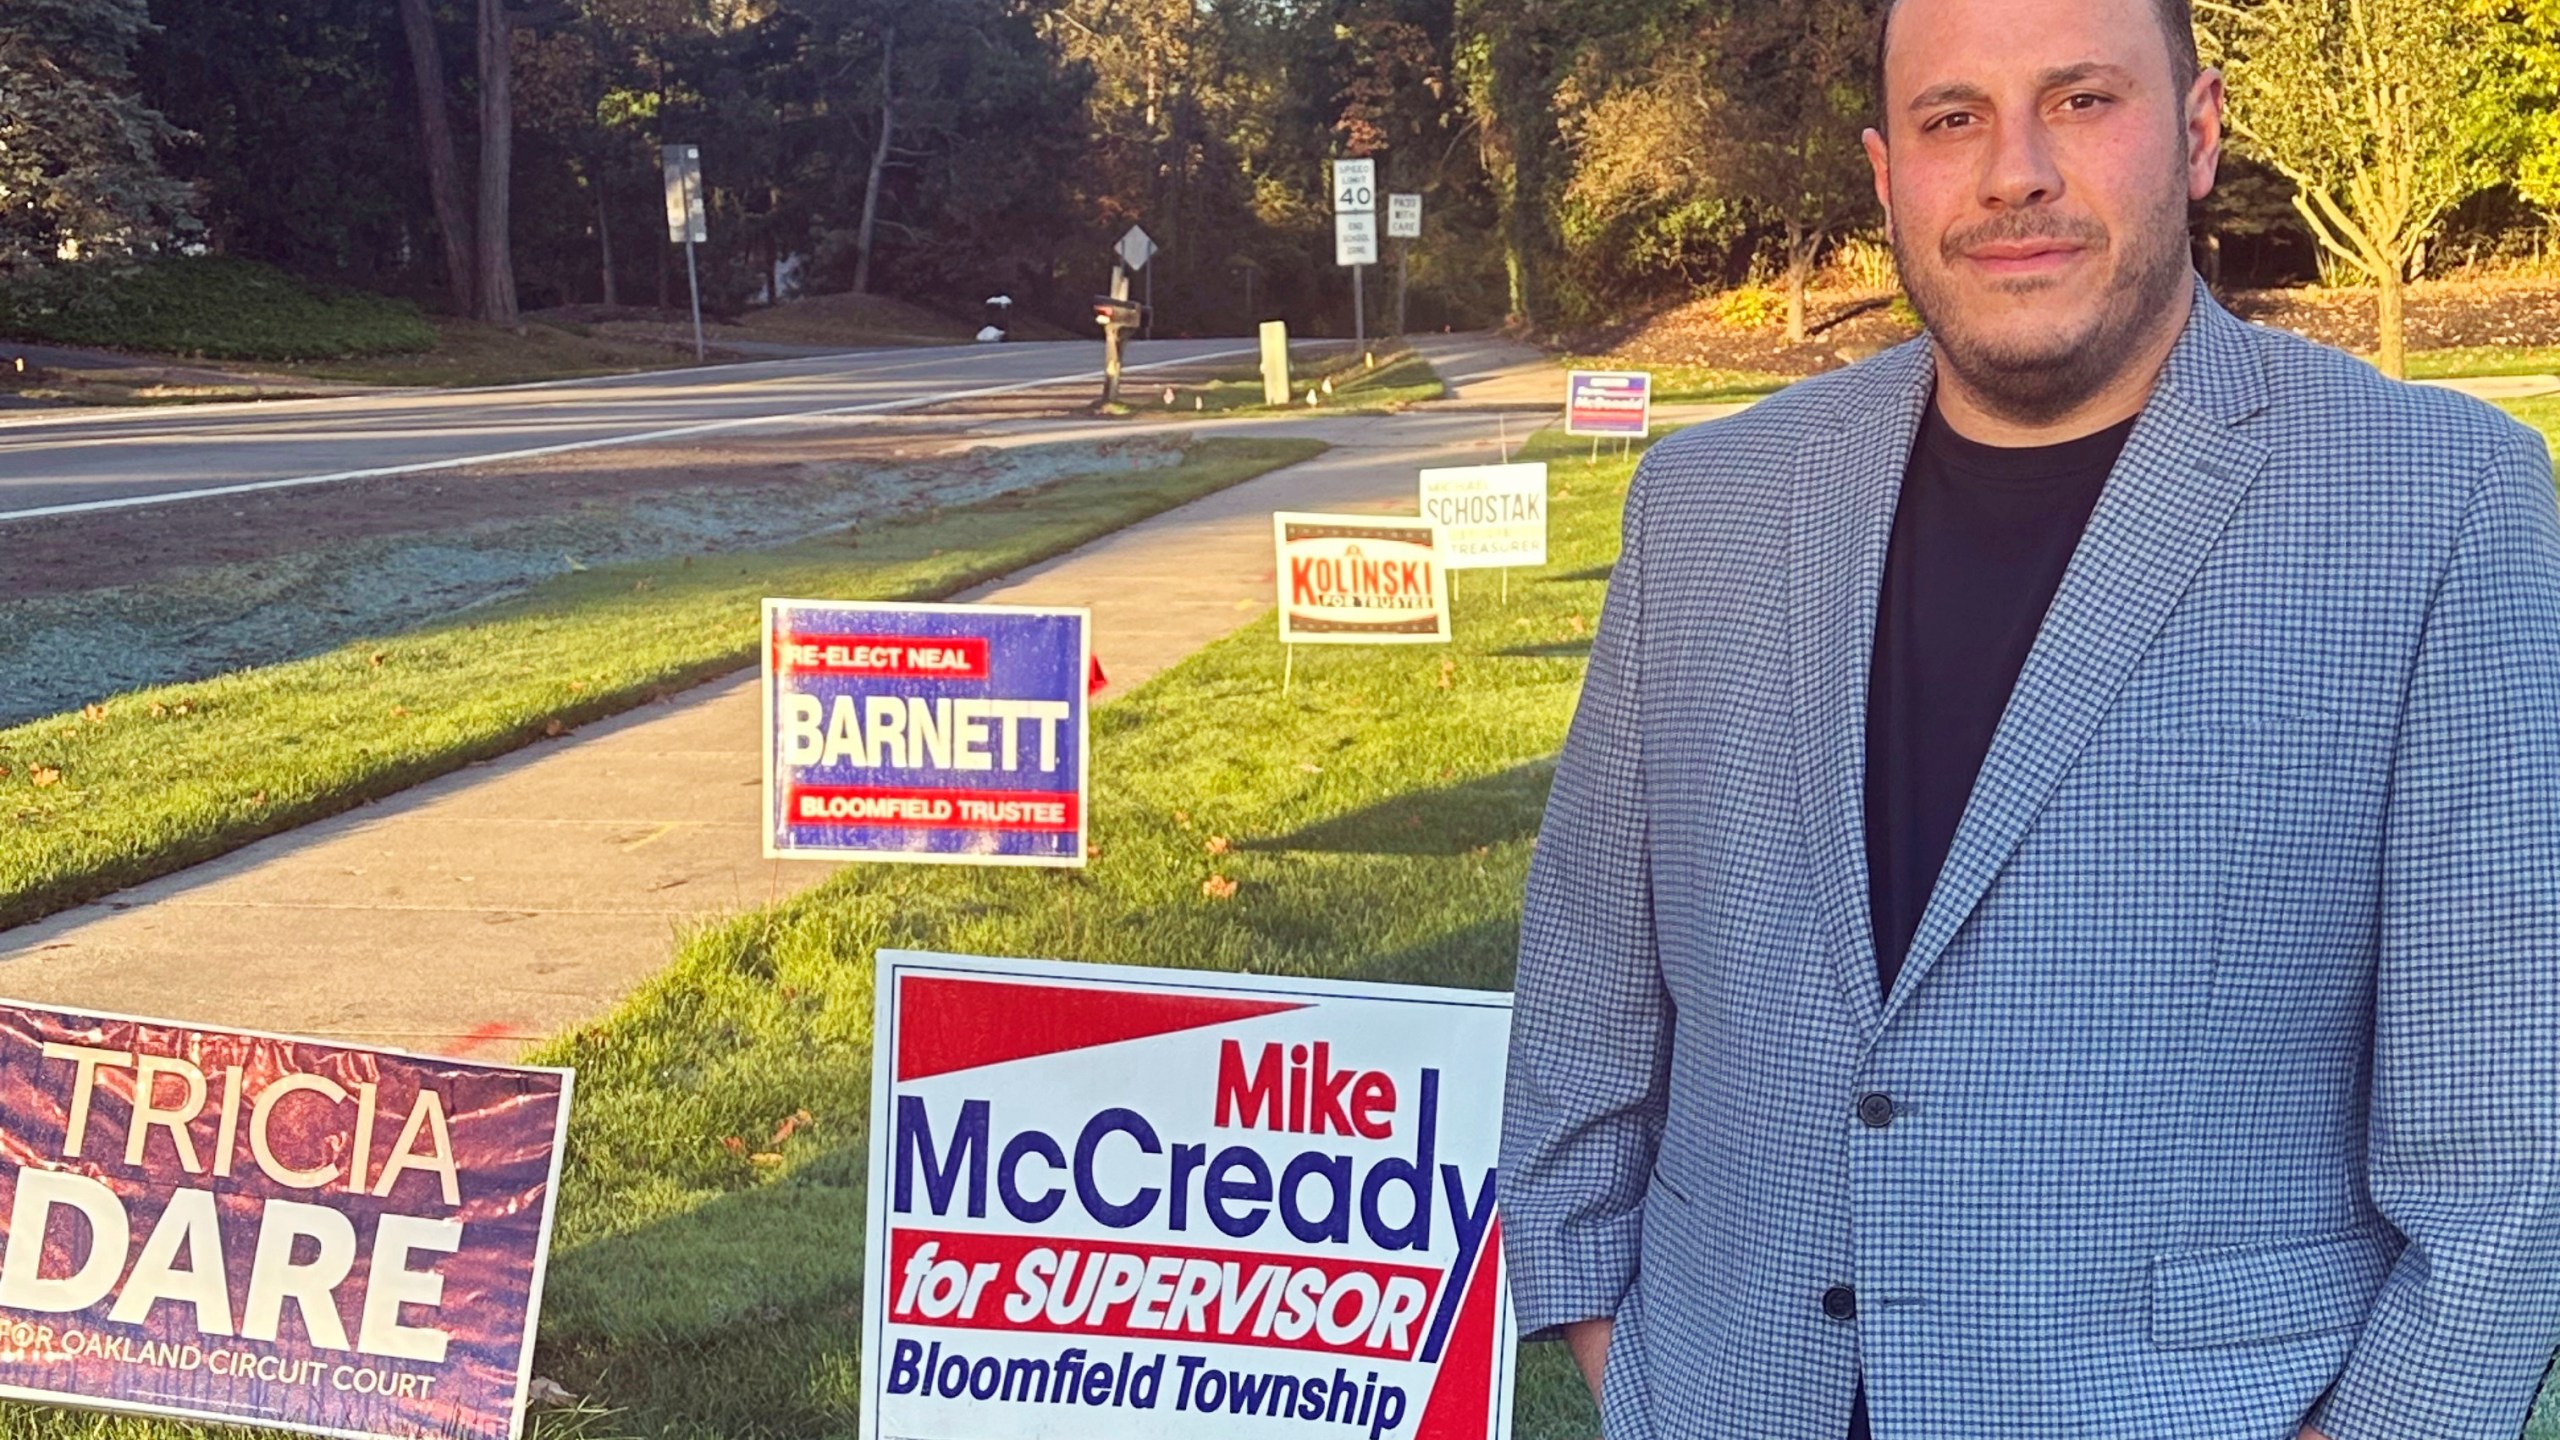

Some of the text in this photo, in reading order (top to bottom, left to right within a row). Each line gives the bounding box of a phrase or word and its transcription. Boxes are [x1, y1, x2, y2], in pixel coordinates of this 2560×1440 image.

[1339, 165, 1369, 173] SPEED
[1342, 176, 1366, 184] LIMIT
[1339, 187, 1371, 205] 40
[1348, 222, 1363, 230] END
[1392, 223, 1415, 231] CARE
[1427, 493, 1540, 525] SCHOSTAK
[1451, 541, 1540, 554] TREASURER
[1291, 556, 1432, 606] KOLINSKI
[1321, 596, 1433, 609] FOR TRUSTEE
[788, 644, 971, 669] RE-ELECT NEAL
[784, 693, 1069, 772] BARNETT
[800, 796, 1065, 823] BLOOMFIELD TRUSTEE
[1214, 1039, 1397, 1139] Mike
[42, 1041, 462, 1207] TRICIA
[892, 1067, 1499, 1364] McCready
[0, 1166, 464, 1364] DARE
[895, 1242, 1428, 1354] for SUPERVISOR
[0, 1319, 436, 1401] FOR OAKLAND CIRCUIT COURT
[887, 1338, 1406, 1440] Bloomfield Township
